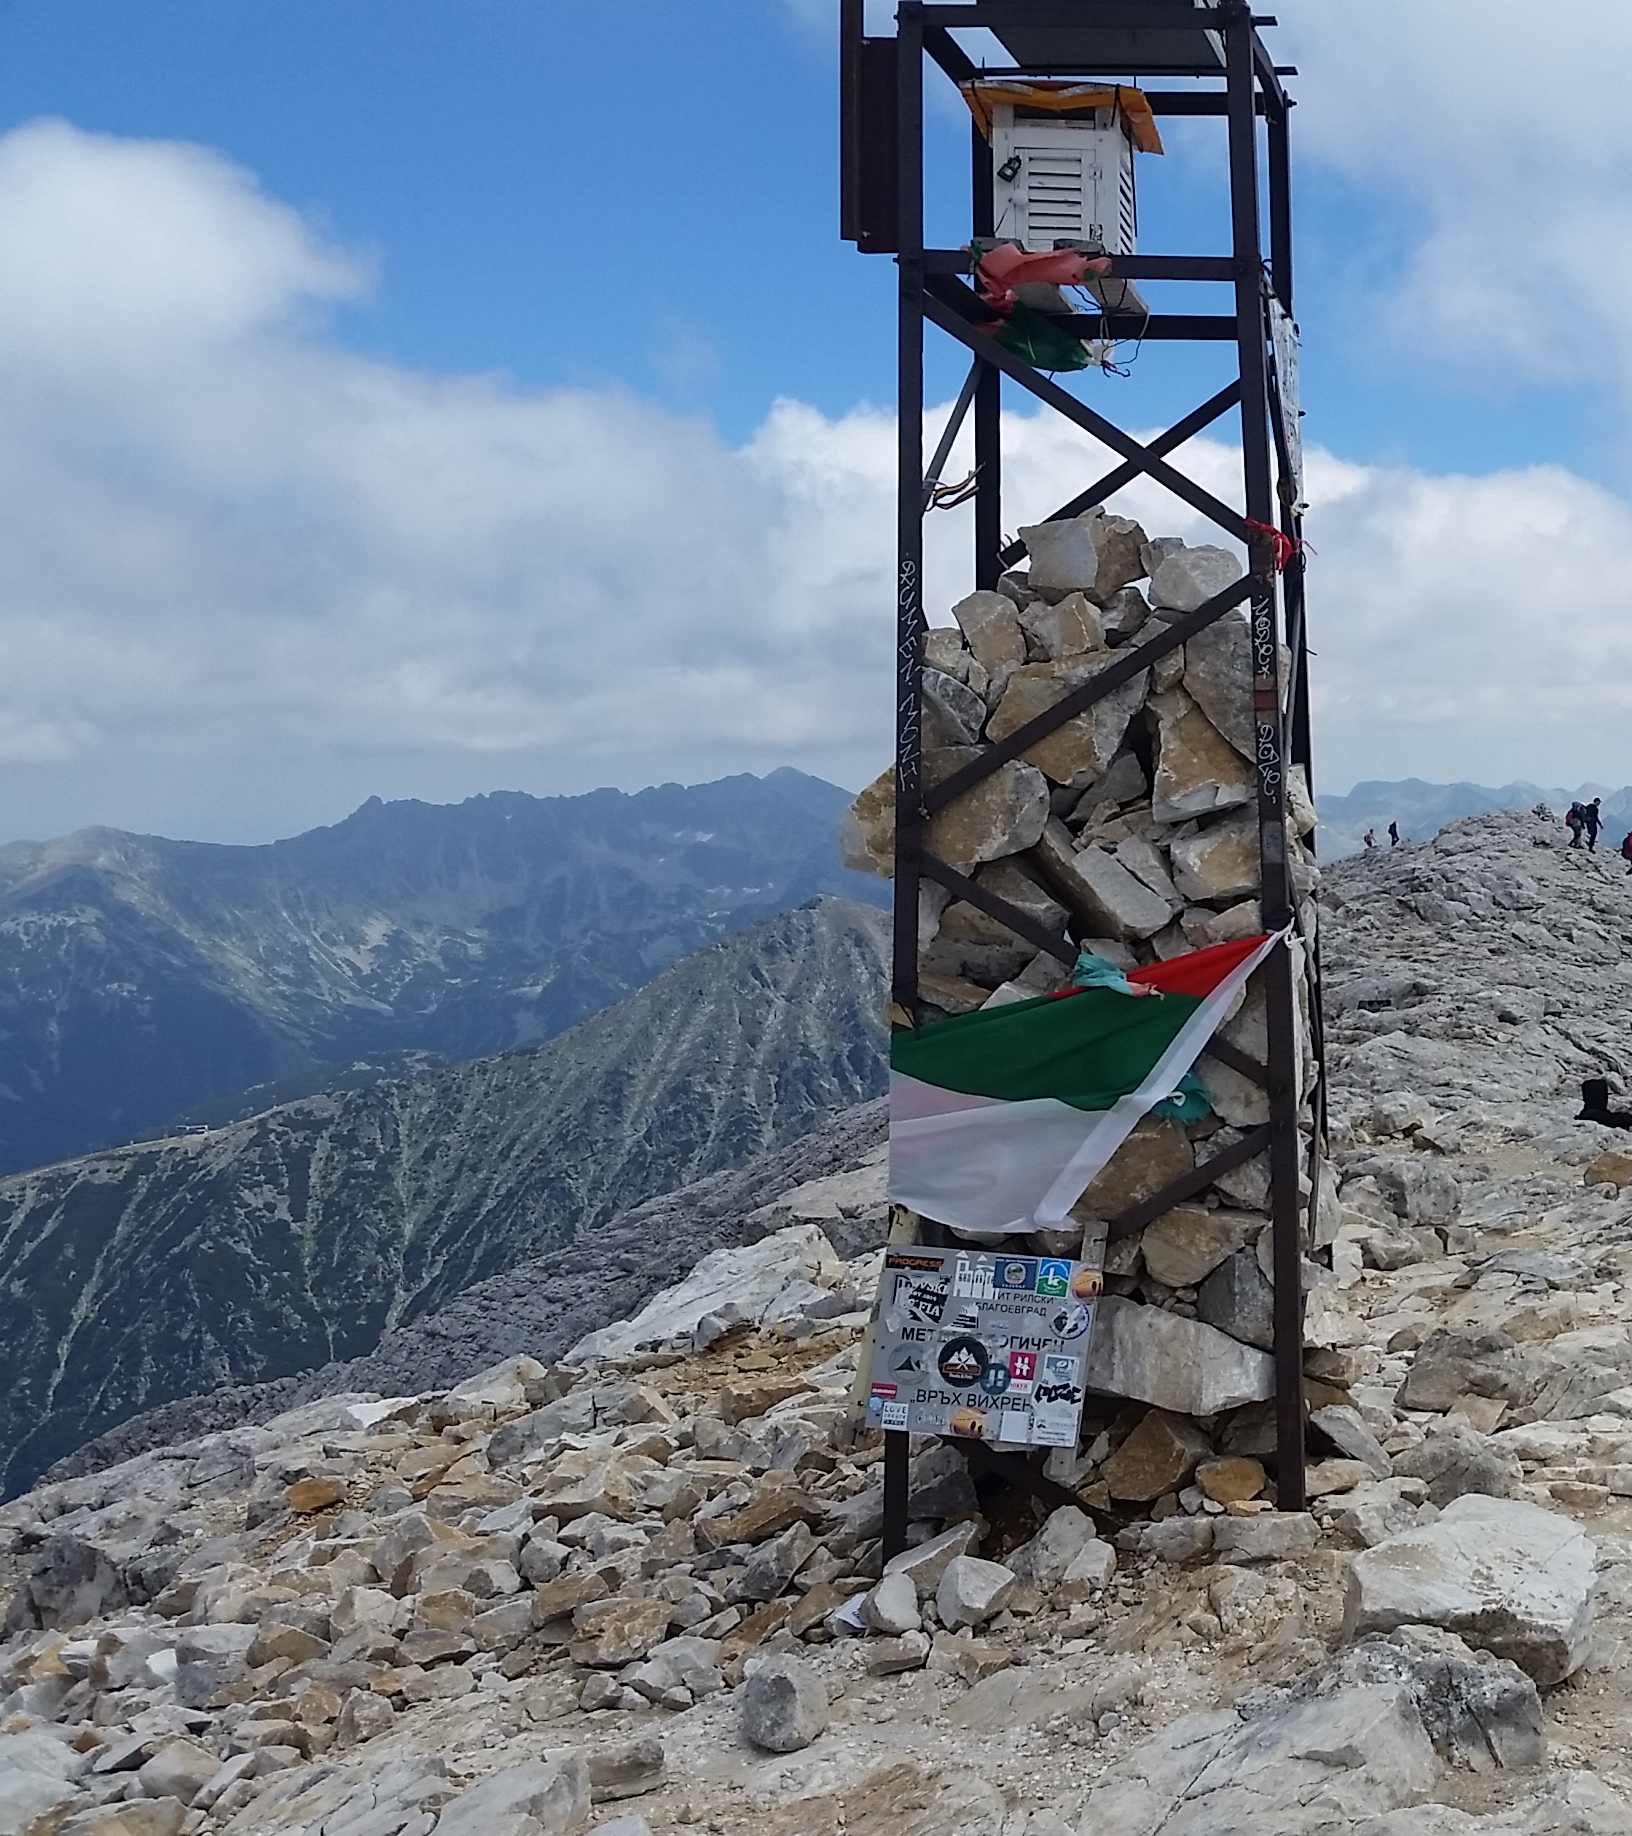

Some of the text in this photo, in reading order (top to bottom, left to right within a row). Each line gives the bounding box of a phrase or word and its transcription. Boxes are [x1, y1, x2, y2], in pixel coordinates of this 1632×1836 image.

[888, 1257, 942, 1268] PROGRESS
[976, 1302, 1047, 1317] БЛАГОЕВГРАД
[885, 1405, 907, 1414] LOVE
